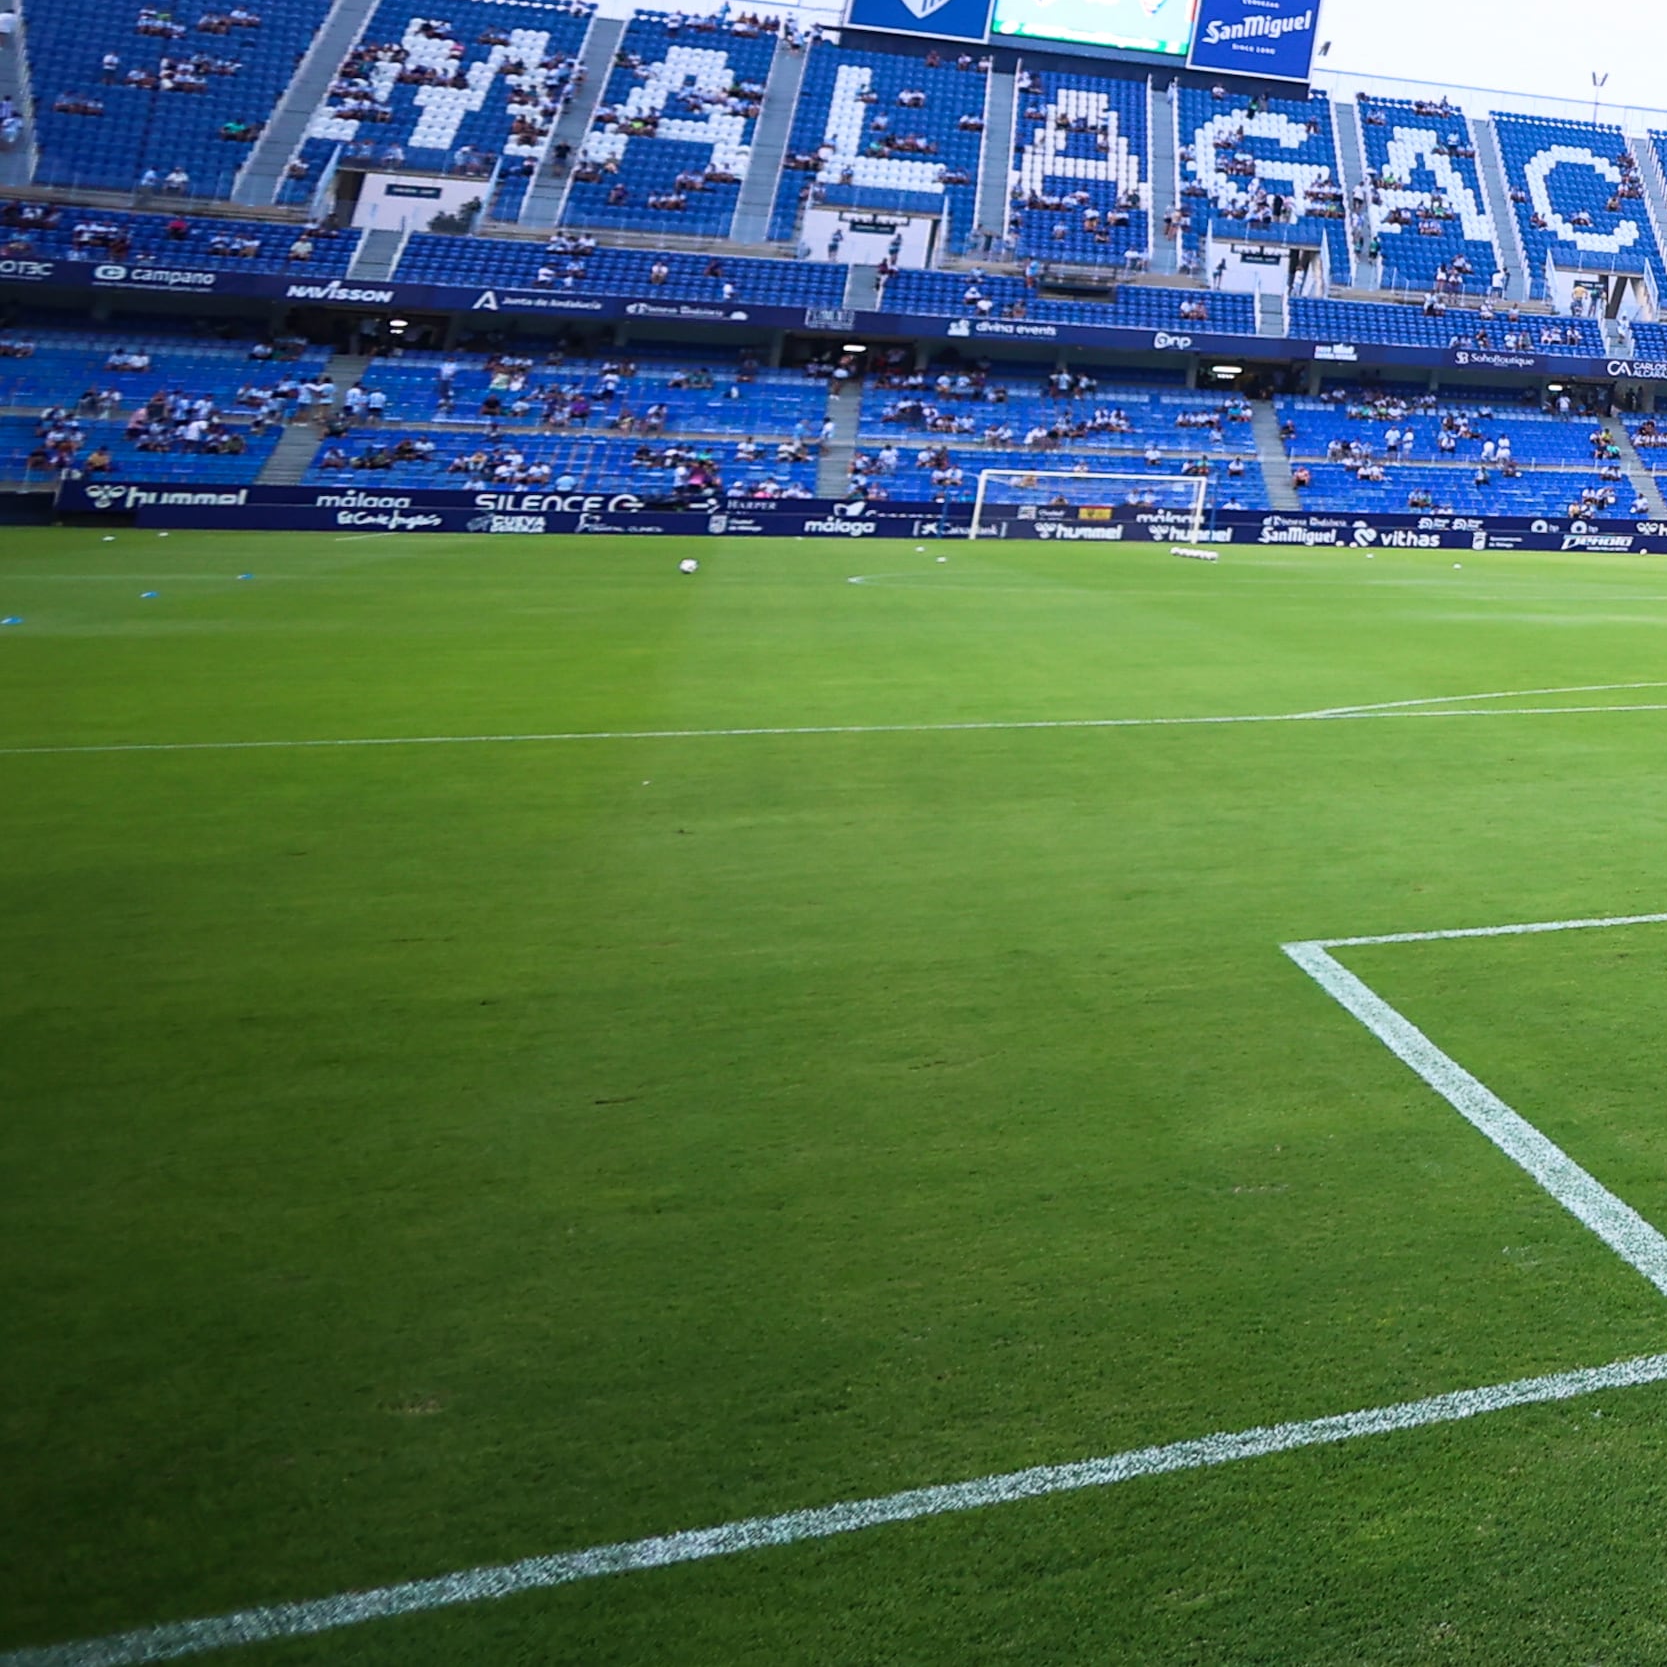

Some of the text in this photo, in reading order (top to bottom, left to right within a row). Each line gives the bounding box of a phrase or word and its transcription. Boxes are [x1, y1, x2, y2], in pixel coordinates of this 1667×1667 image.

[1202, 9, 1312, 45] SanMiguel
[130, 268, 216, 285] campano
[474, 493, 605, 512] SILENCE
[804, 516, 876, 537] málaga
[1056, 524, 1124, 540] hummel
[1258, 526, 1337, 546] SanMiguel
[1381, 530, 1441, 547] vithas
